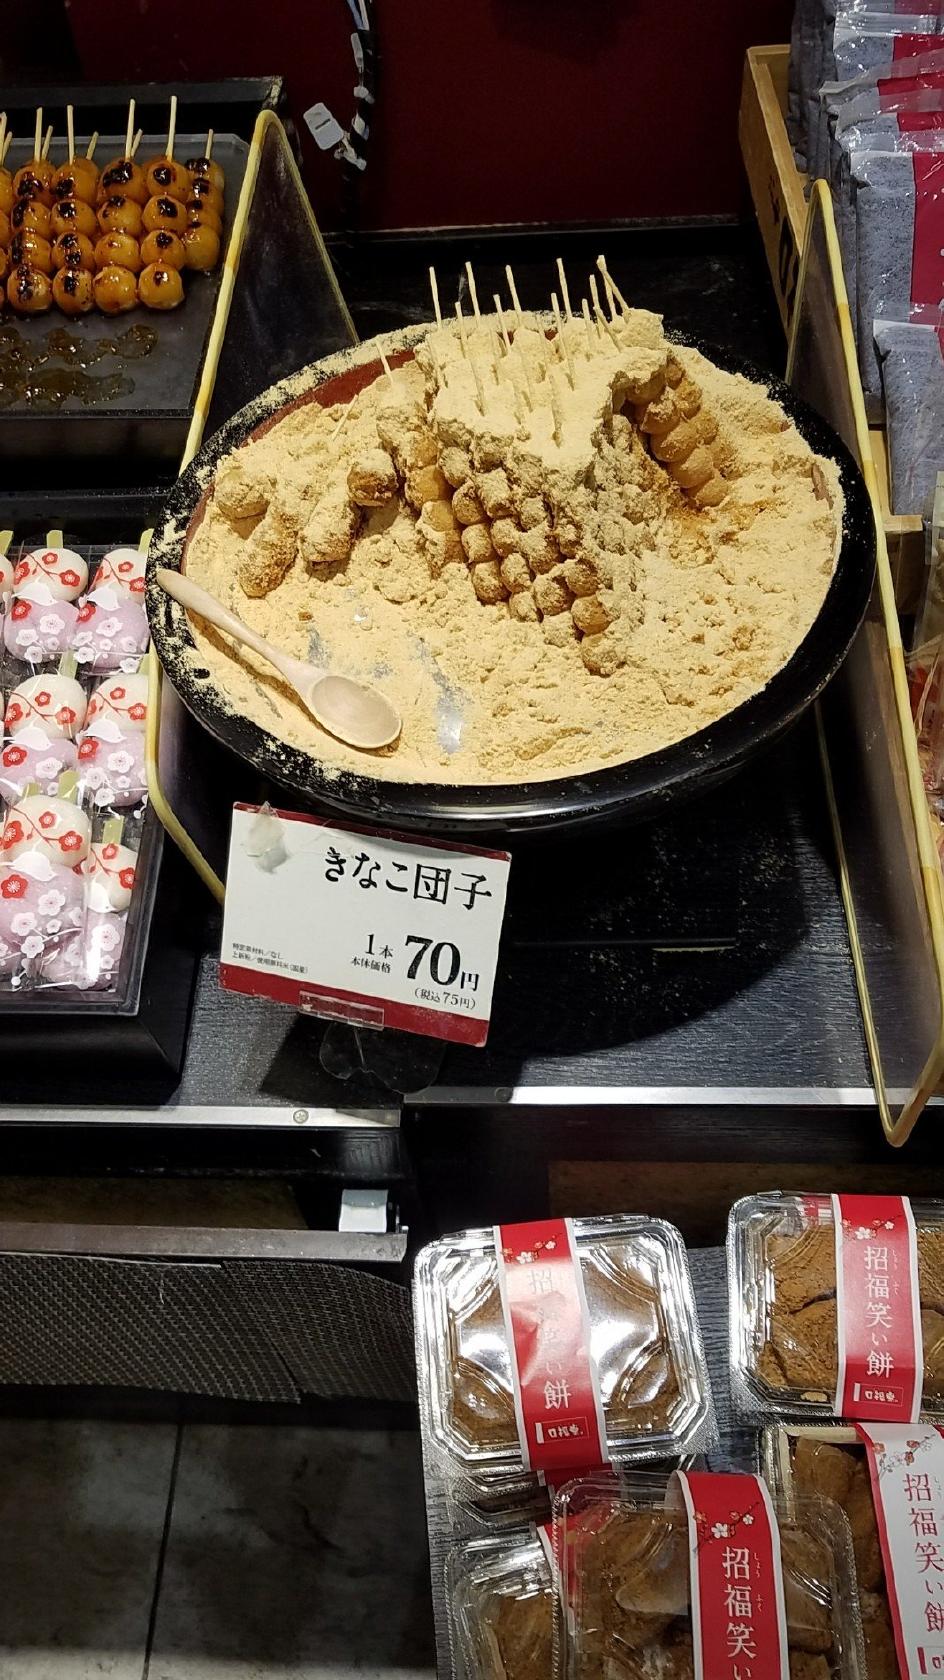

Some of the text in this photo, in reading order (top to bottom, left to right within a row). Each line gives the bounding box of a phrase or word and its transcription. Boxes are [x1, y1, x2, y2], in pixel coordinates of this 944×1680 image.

[324, 847, 492, 910] きなこ団子
[350, 956, 391, 974] 本体価格
[365, 933, 394, 959] 1本
[405, 935, 479, 991] 70円
[527, 1268, 572, 1410] 招い餅
[863, 1246, 895, 1379] 招福笑い餅
[722, 1546, 758, 1680] 招福笑い
